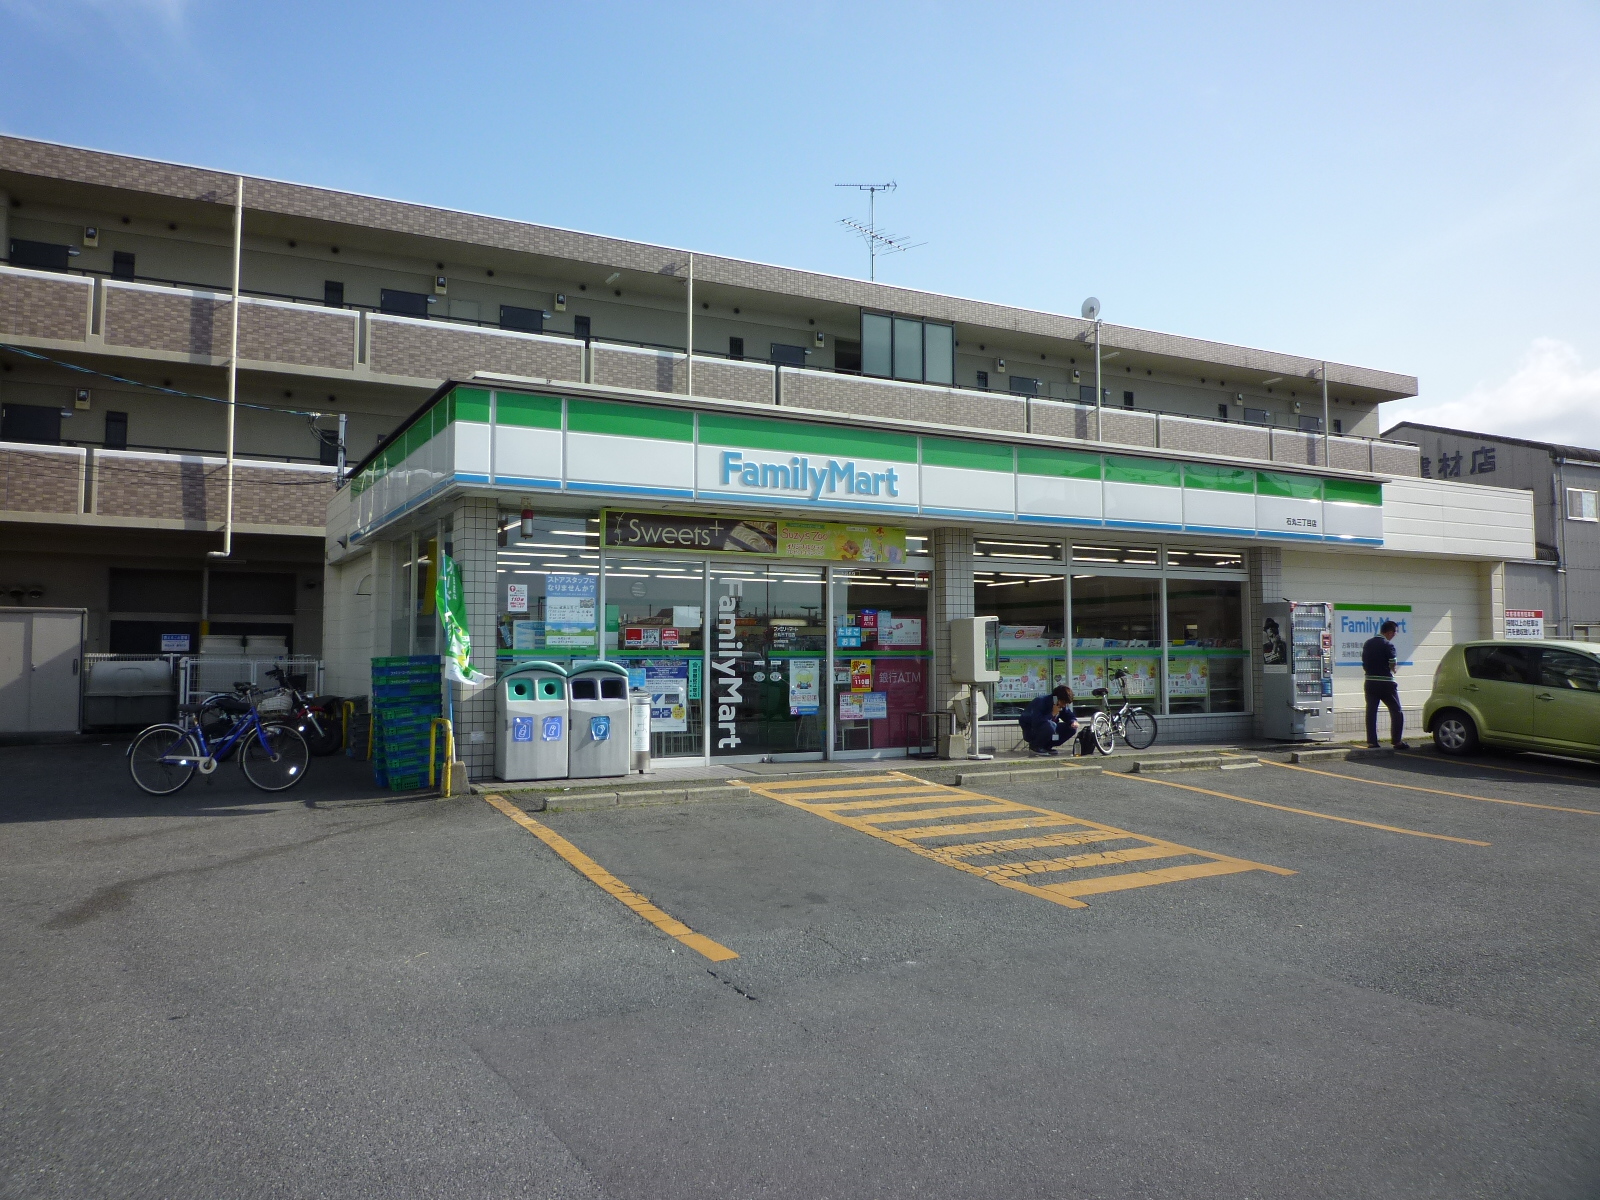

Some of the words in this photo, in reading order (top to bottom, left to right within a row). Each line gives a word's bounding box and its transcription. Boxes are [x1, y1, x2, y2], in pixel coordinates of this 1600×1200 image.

[722, 451, 900, 501] FamilyMart
[1286, 517, 1317, 528] 石丸三丁目店
[1341, 616, 1406, 636] Familyrt
[841, 638, 856, 646] お酒
[712, 579, 743, 749] FamilyMart
[879, 672, 920, 683] 銀行ATM
